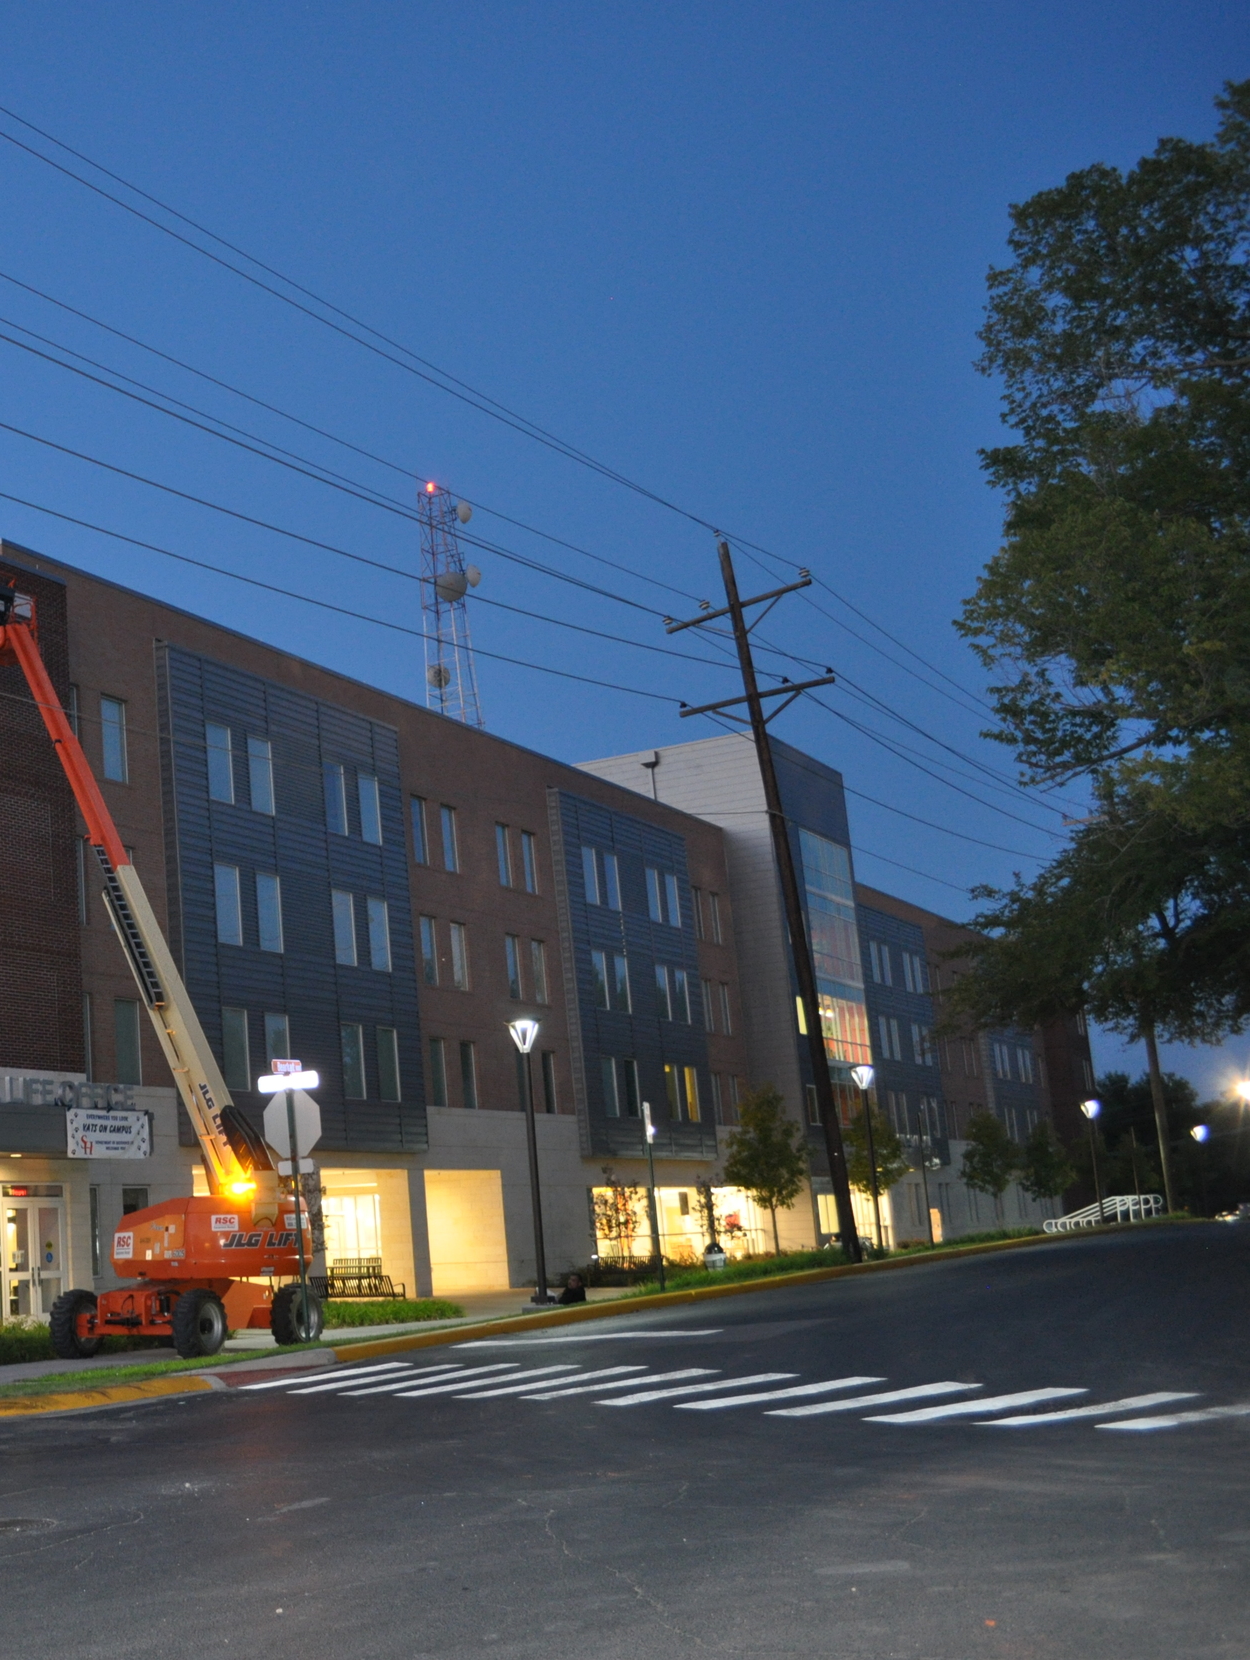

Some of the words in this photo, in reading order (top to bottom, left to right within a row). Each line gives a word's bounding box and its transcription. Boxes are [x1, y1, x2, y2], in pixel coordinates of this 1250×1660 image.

[5, 1075, 54, 1106] LIFE
[55, 1080, 136, 1110] OFFICE
[198, 1083, 215, 1110] JLG
[82, 1123, 98, 1133] KATS
[98, 1124, 108, 1134] ON
[109, 1124, 132, 1134] CAMPUS
[215, 1216, 236, 1224] RSC
[116, 1236, 131, 1248] RSC
[222, 1232, 262, 1248] JLG
